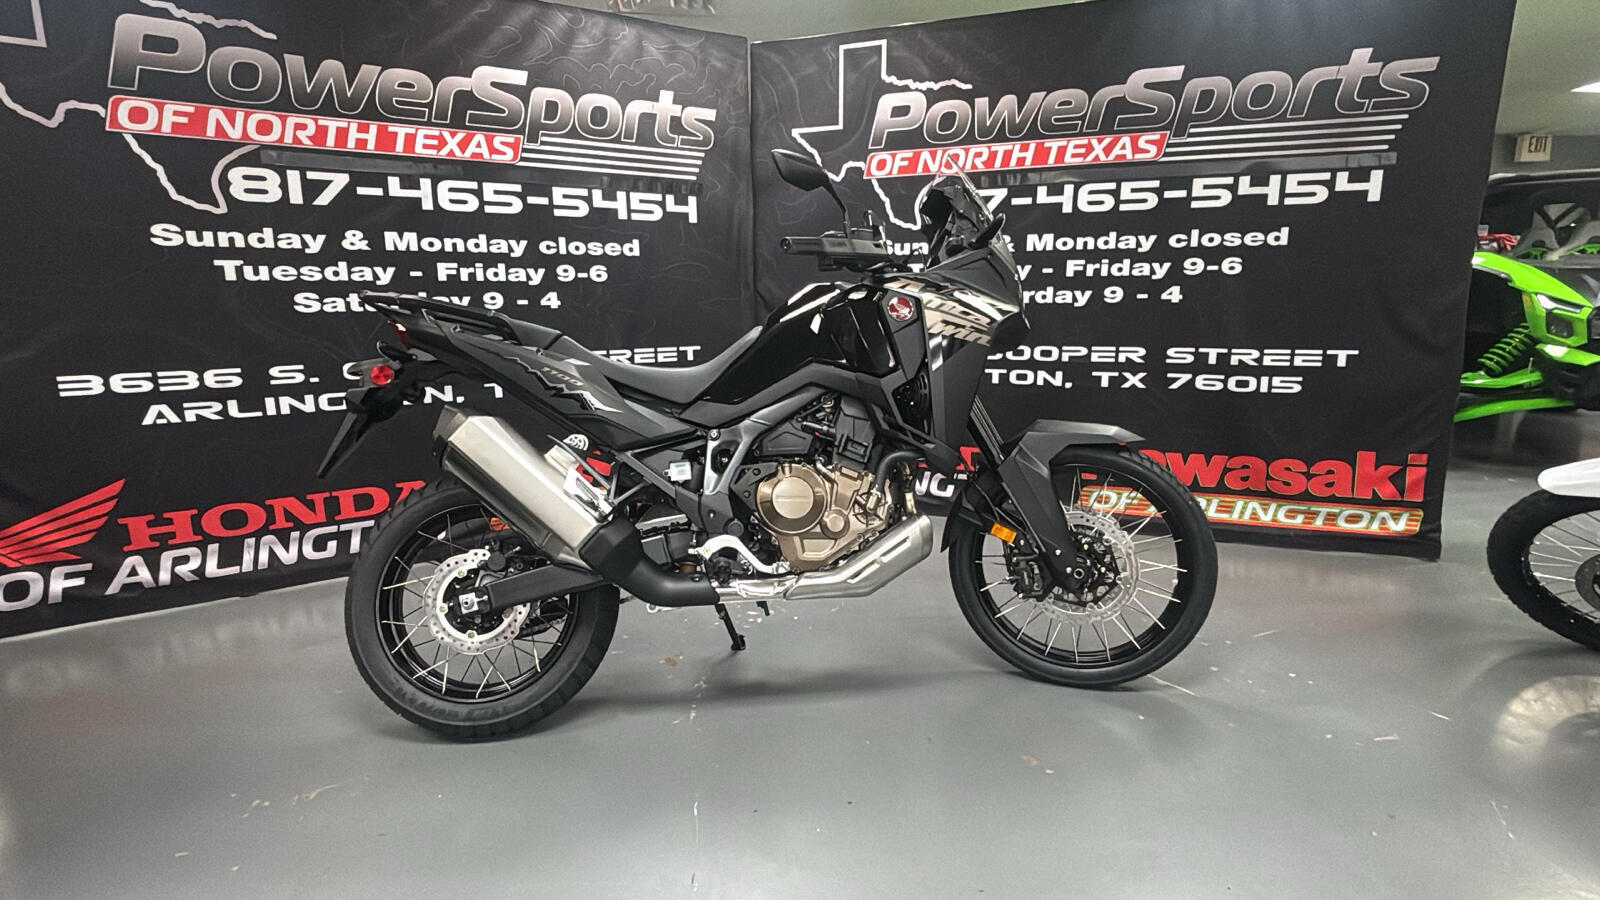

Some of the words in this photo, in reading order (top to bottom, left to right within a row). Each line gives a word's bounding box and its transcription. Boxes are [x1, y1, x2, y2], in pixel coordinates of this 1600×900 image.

[107, 13, 717, 149] PowerSports
[868, 47, 1440, 150] PowerSports
[117, 100, 195, 133] OF
[206, 108, 378, 151] NORTH
[388, 125, 515, 161] TEXAS
[870, 152, 912, 176] OF
[916, 149, 1037, 174] NORTH
[1044, 134, 1161, 163] TEXAS
[227, 166, 699, 224] 817-465-5454
[974, 169, 1384, 214] 7-465-5454
[150, 223, 326, 254] Sunday
[341, 230, 371, 250] &
[384, 231, 528, 258] Monday
[539, 236, 641, 257] closed
[1026, 232, 1157, 252] Monday
[1168, 227, 1289, 248] closed
[213, 259, 396, 285] Tuesday
[437, 262, 545, 285] Friday
[556, 265, 609, 282] 9-6
[1065, 258, 1172, 280] Friday
[1183, 257, 1243, 275] 9-6
[482, 292, 504, 310] 9
[540, 291, 562, 309] 4
[1022, 286, 1093, 307] rday
[1103, 286, 1124, 303] 9
[1160, 286, 1183, 303] 4
[1165, 347, 1359, 368] STREET
[56, 367, 245, 397] 3636
[268, 364, 319, 385] S.
[1091, 371, 1147, 389] TX
[1167, 373, 1303, 394] 76015
[1152, 497, 1410, 533] LINGTON
[0, 563, 93, 612] OF
[104, 520, 375, 596] ARLINGT
